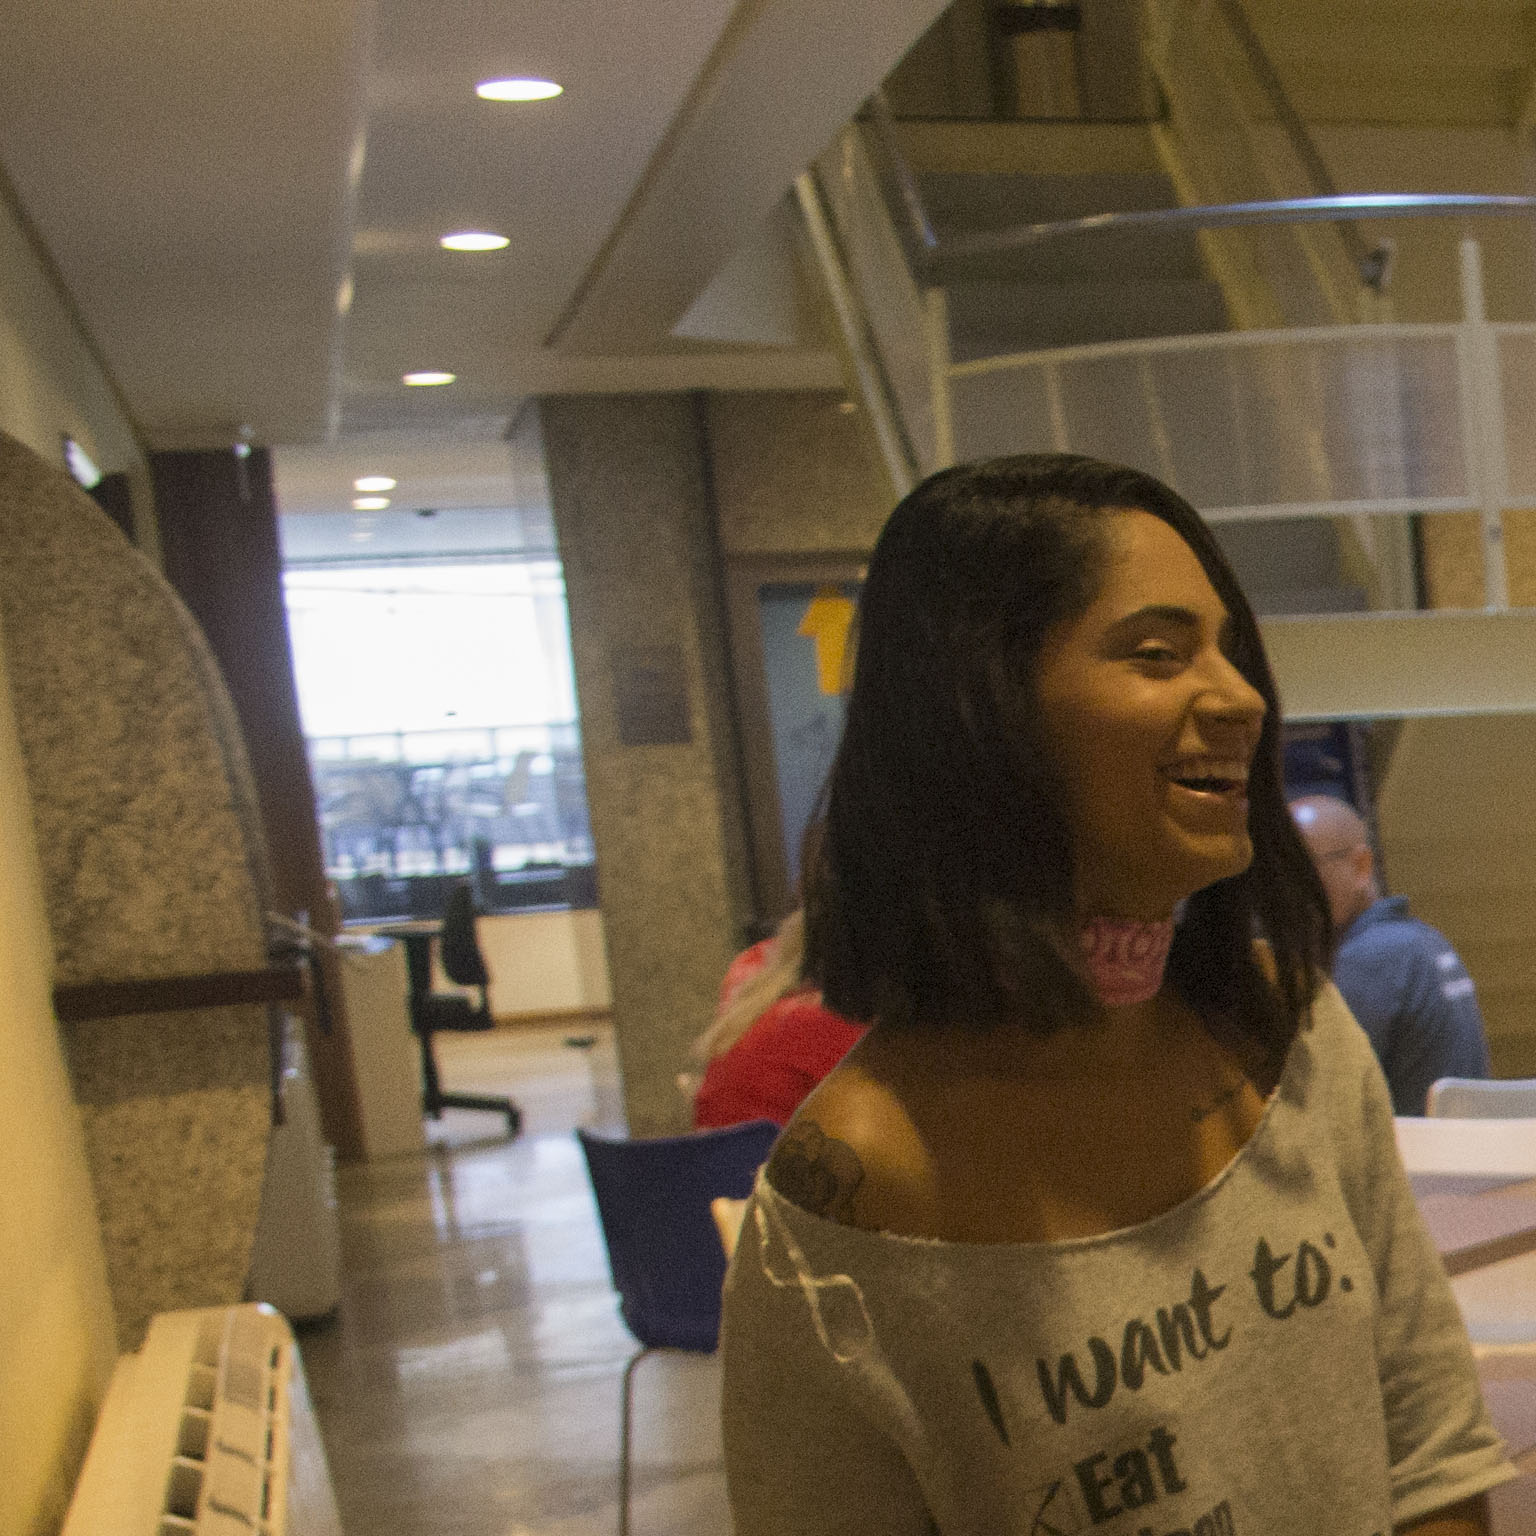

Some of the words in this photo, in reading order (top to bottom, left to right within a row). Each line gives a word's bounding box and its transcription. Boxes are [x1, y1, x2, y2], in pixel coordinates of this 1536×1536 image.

[971, 1356, 1012, 1448] I
[1036, 1268, 1235, 1427] want
[1074, 1425, 1188, 1526] Eat
